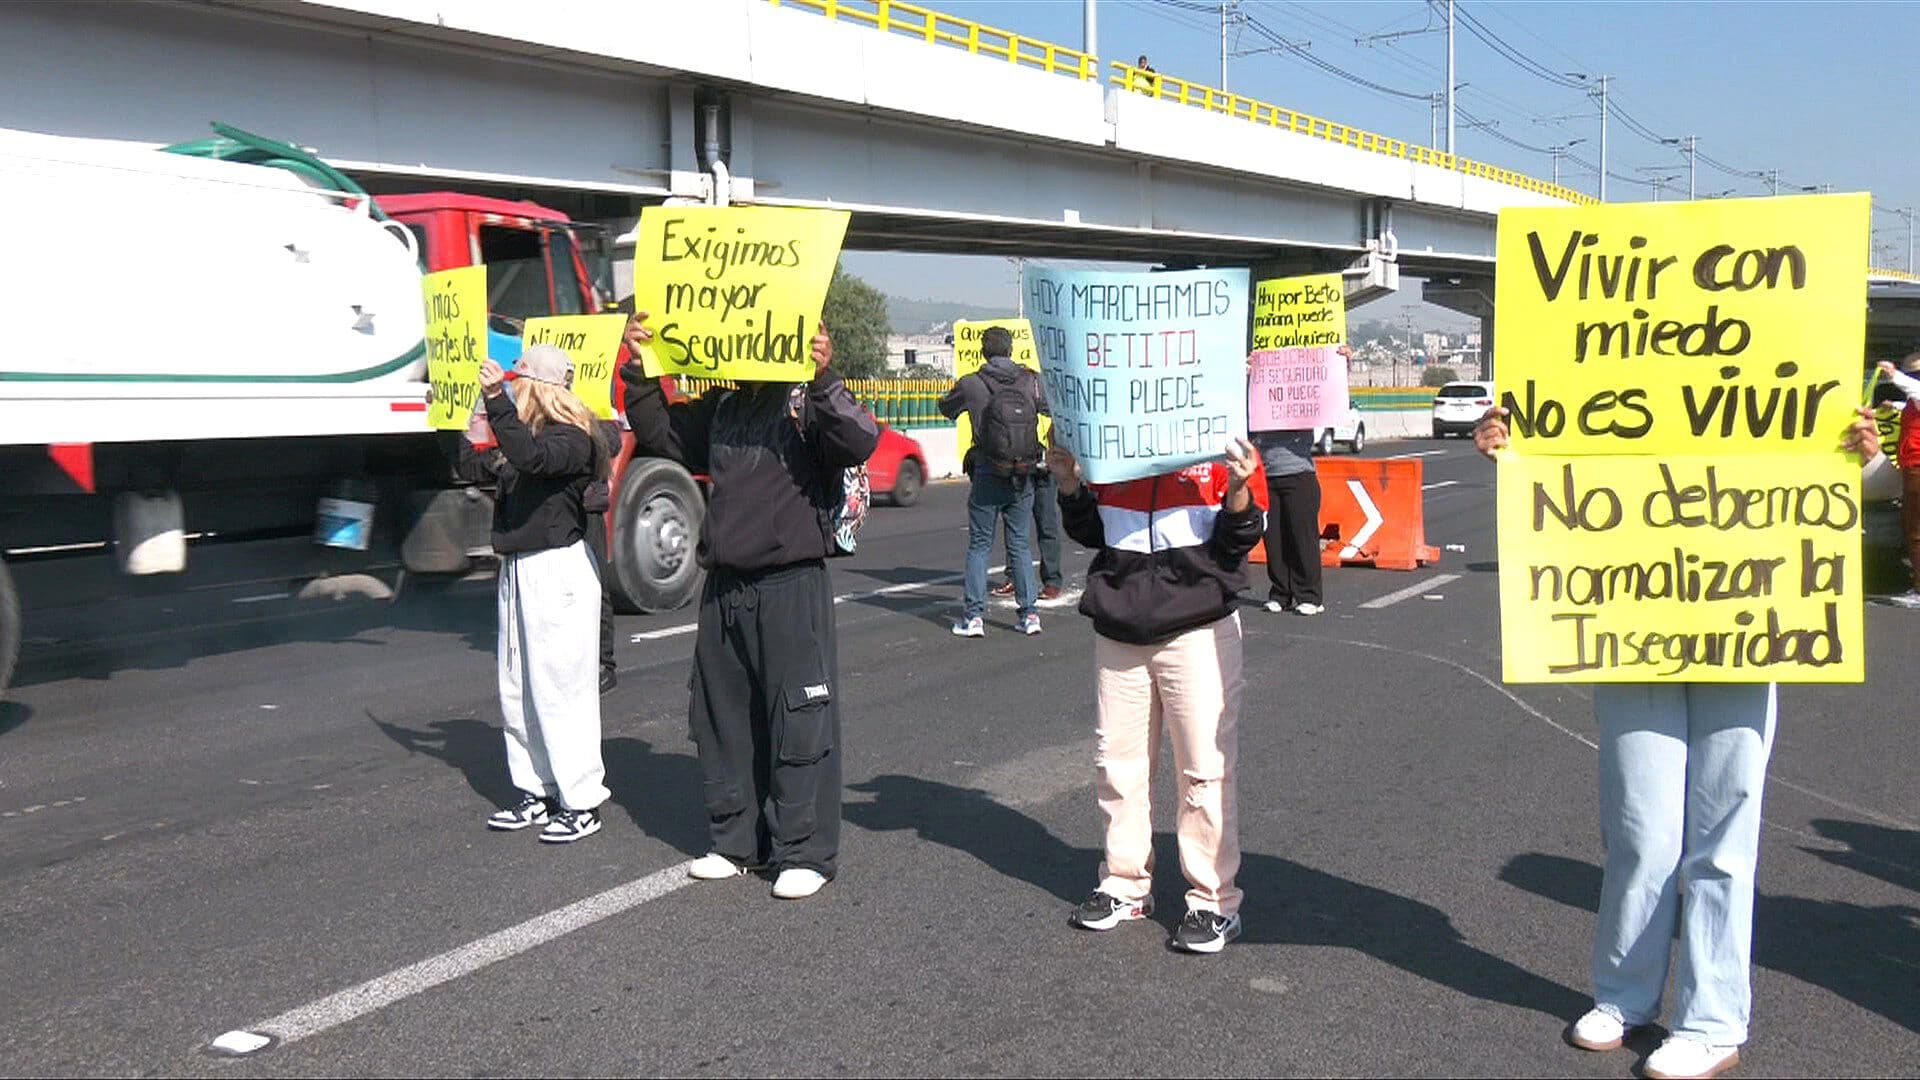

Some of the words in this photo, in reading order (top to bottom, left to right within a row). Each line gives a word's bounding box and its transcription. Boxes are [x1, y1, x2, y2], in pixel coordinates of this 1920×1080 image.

[662, 219, 801, 280] Exigimos
[1527, 230, 1678, 302] Vivir
[1693, 244, 1806, 291] con
[432, 280, 460, 325] más
[666, 283, 767, 323] mayor
[1031, 279, 1063, 316] HOY
[1071, 279, 1230, 322] MARCHAMOS
[1278, 290, 1302, 311] por
[1304, 282, 1341, 304] Beto
[463, 321, 478, 363] de
[554, 332, 588, 352] una
[661, 310, 804, 371] Seguridad
[1020, 349, 1031, 360] a
[1040, 325, 1066, 362] POR
[1253, 334, 1270, 349] ser
[1274, 329, 1341, 348] cualquiera
[1575, 305, 1751, 363] miedo
[579, 352, 609, 382] más
[1130, 374, 1204, 414] PUEDE
[1268, 387, 1283, 402] NO
[1501, 380, 1566, 438] No
[1577, 388, 1653, 438] es
[1682, 361, 1840, 440] vivir
[1533, 464, 1622, 532] No
[1643, 463, 1857, 531] debemos
[1530, 548, 1786, 605] normalizar
[1801, 539, 1844, 598] la
[1549, 602, 1843, 676] Inseguridad
